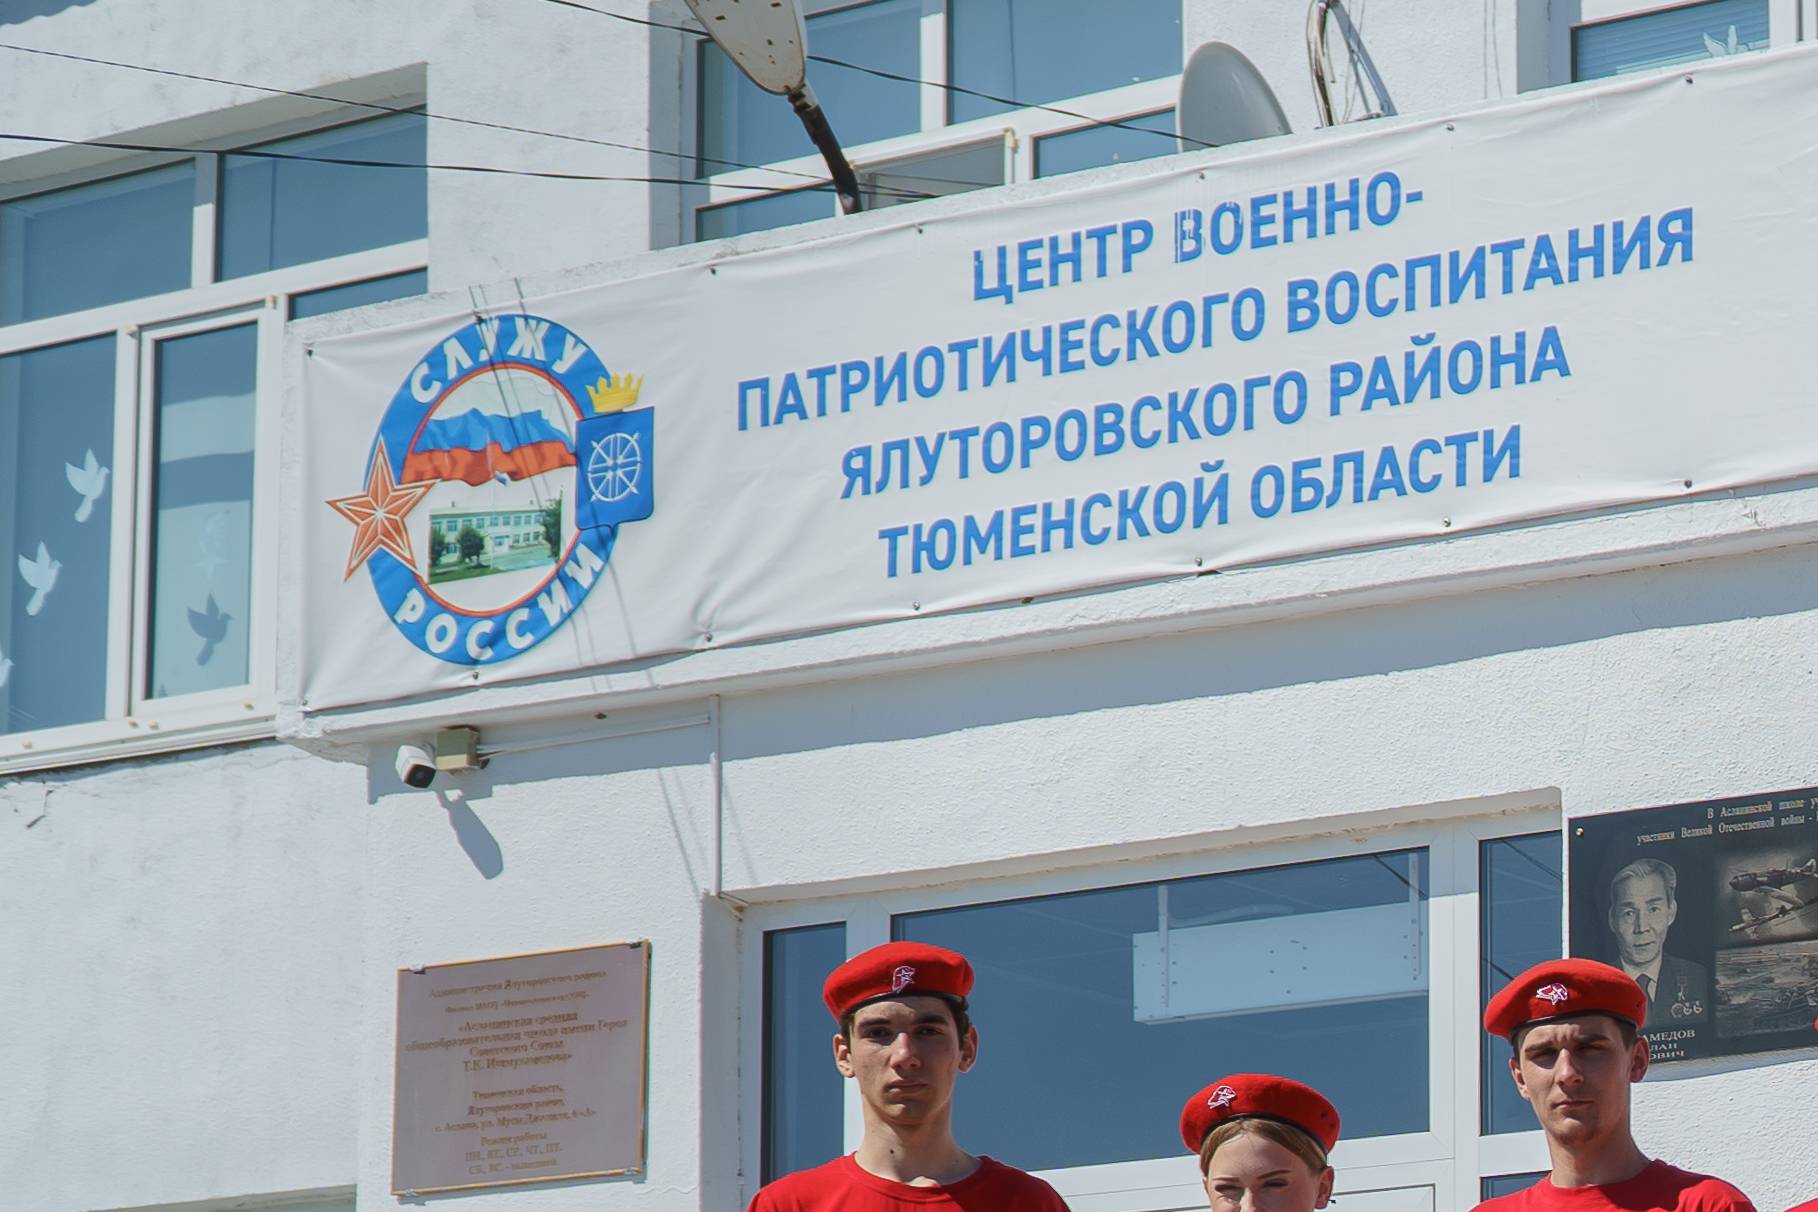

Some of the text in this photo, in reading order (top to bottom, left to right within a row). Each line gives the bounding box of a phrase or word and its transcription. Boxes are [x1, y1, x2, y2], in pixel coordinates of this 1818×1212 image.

[973, 171, 1423, 304] ЦЕНТР ВОЕННО-
[410, 316, 588, 404] СЛУЖУ
[737, 207, 1694, 431] ПАТРИОТИЧЕСКОГО ВОСПИТАНИЯ
[840, 326, 1572, 500] ЯЛУТОРОВСКОГО РАЙОНА
[878, 424, 1521, 577] ТЮМЕНСКОЙ ОБЛАСТИ
[394, 548, 604, 660] РОССИИ
[1681, 824, 1713, 838] Великой
[1719, 817, 1775, 833] Отечественной
[1707, 808, 1714, 819] В
